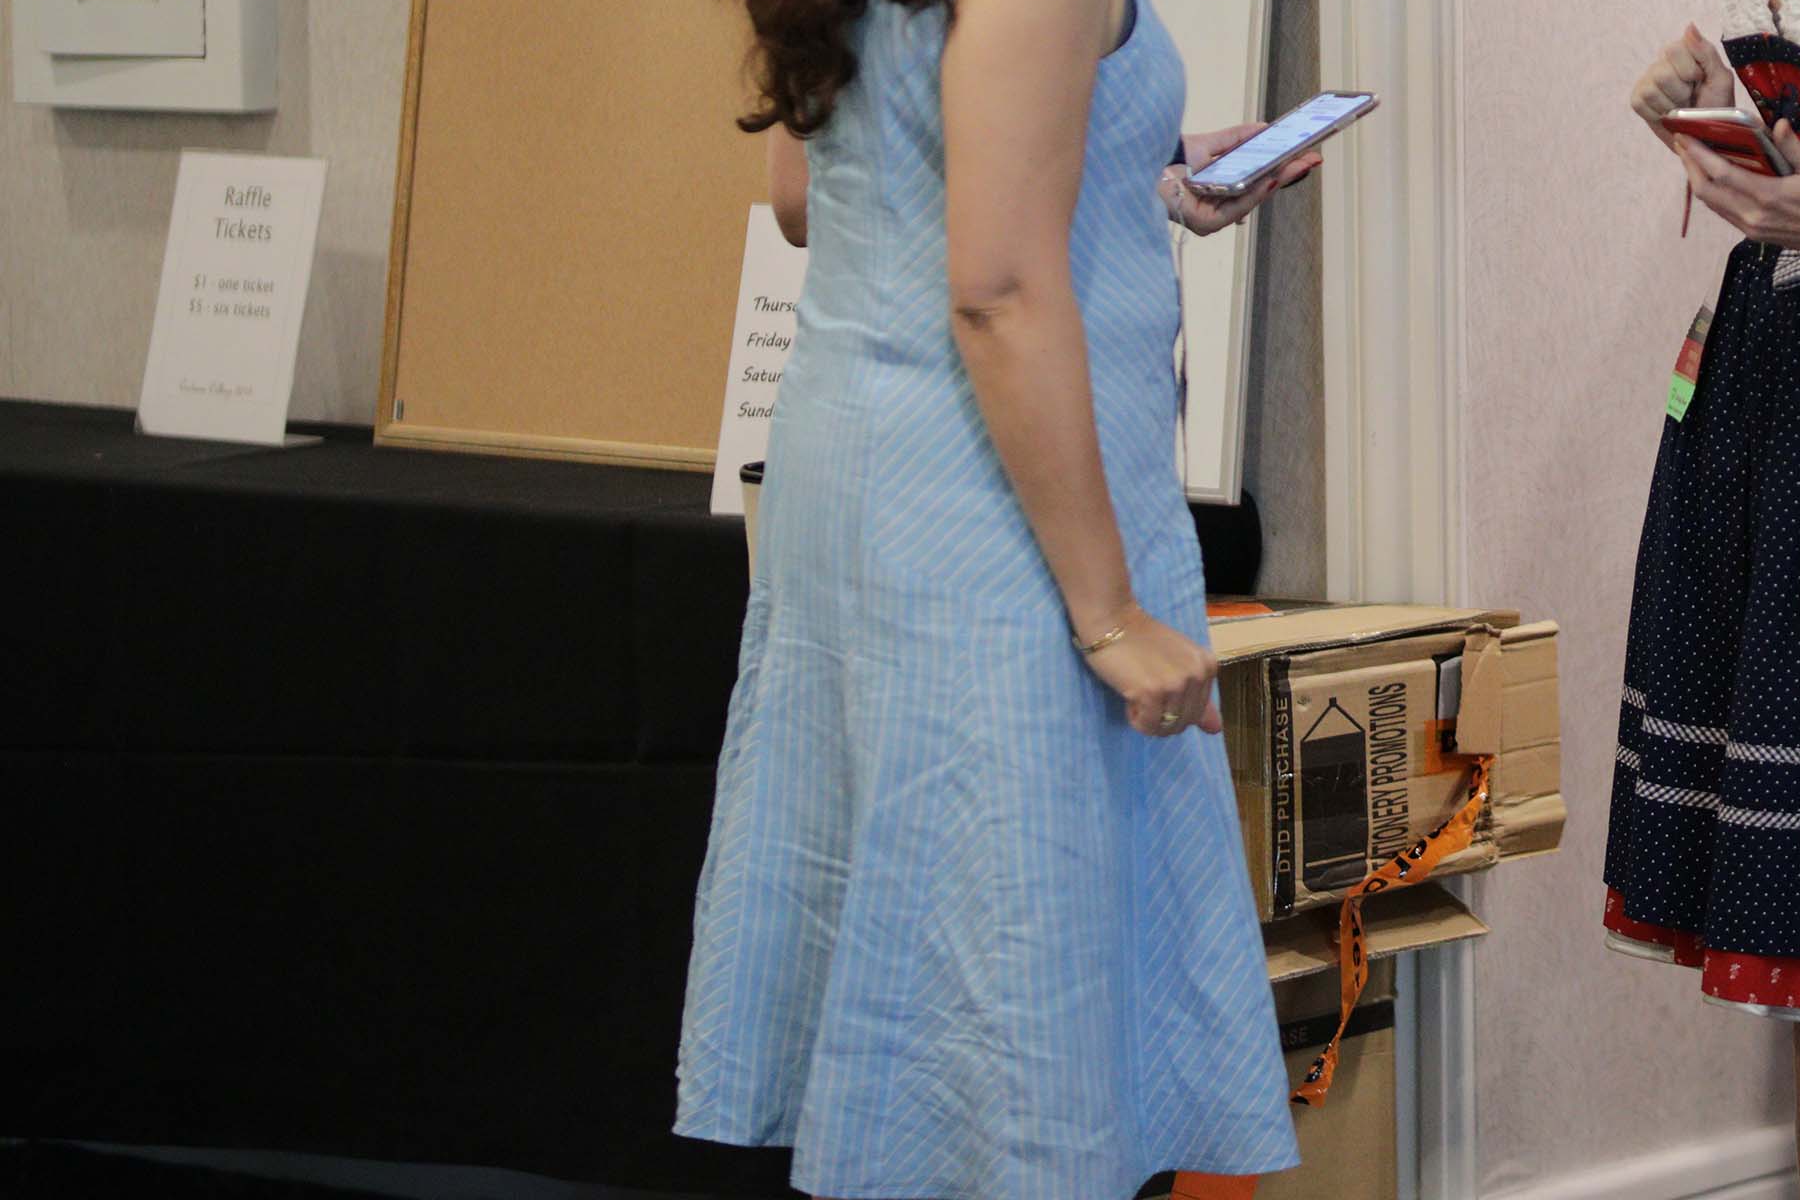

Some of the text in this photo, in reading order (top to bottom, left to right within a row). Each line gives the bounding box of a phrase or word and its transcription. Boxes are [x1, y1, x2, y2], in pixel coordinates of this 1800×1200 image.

[224, 185, 272, 208] Raffle
[214, 217, 273, 241] Tickets
[217, 278, 240, 291] one
[242, 278, 275, 293] ticket
[213, 302, 230, 316] six
[233, 302, 272, 318] tickets
[753, 295, 798, 313] Thurs
[746, 331, 792, 352] Friday
[741, 365, 784, 383] Satur
[737, 400, 776, 418] Sund
[1368, 682, 1408, 787] PROMOTIONS
[1276, 696, 1291, 874] DTD PURCHASE
